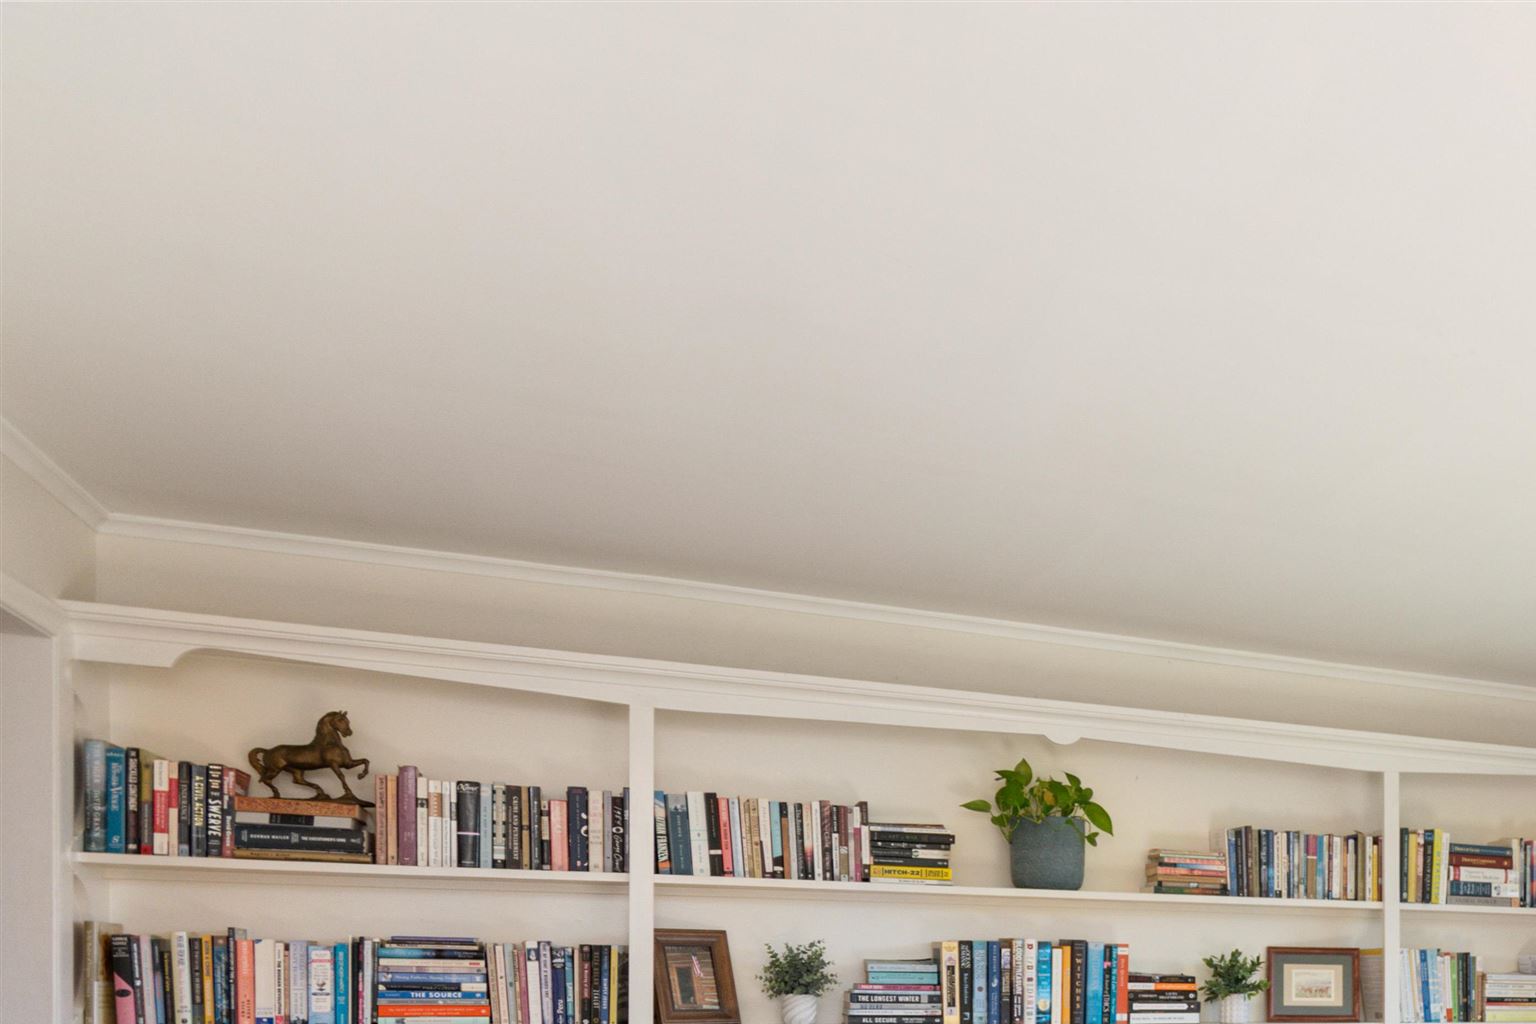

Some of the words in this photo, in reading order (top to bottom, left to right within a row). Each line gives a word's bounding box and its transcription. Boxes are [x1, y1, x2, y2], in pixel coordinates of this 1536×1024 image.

[208, 799, 222, 838] SWERVE
[410, 991, 426, 999] THE
[428, 991, 463, 999] SOURCE
[870, 995, 897, 1003] LONGEST
